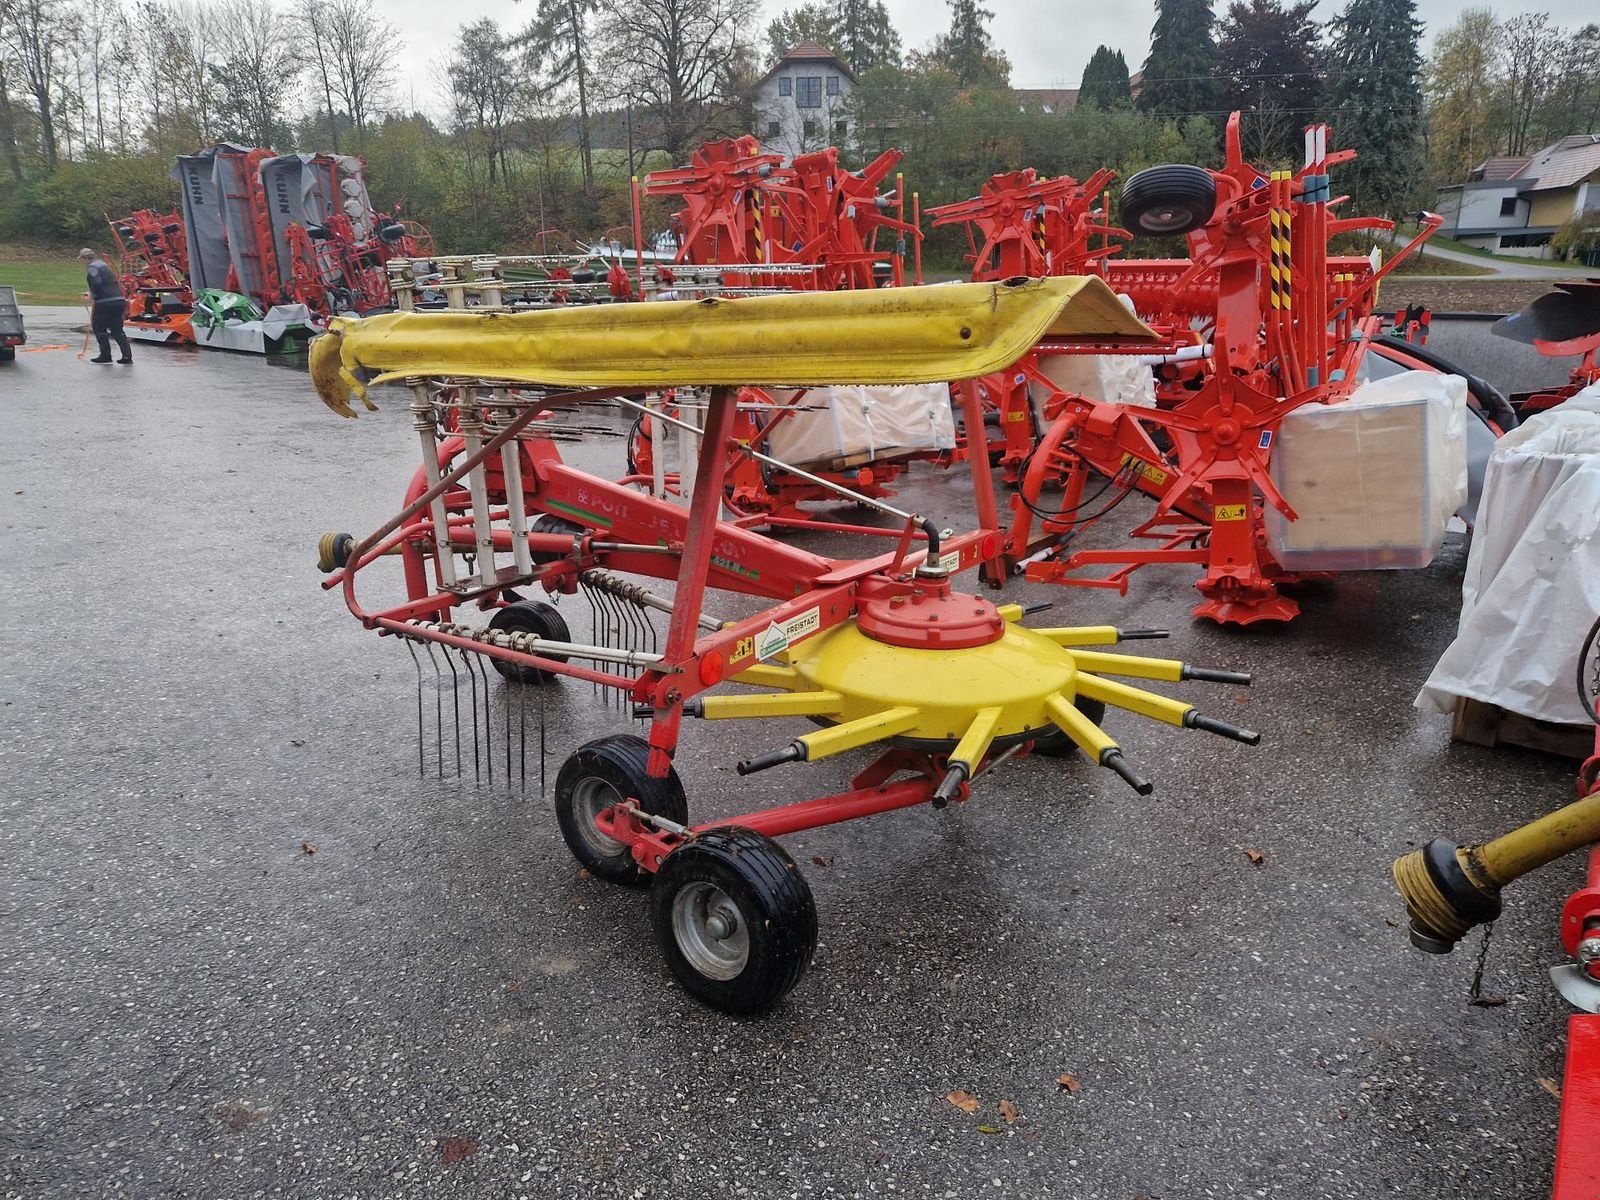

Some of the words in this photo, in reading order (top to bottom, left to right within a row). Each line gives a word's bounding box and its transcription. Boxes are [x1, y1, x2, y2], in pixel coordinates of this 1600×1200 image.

[188, 166, 204, 205] KUHN
[274, 171, 290, 214] KUHN
[786, 614, 818, 635] FREISTADT
